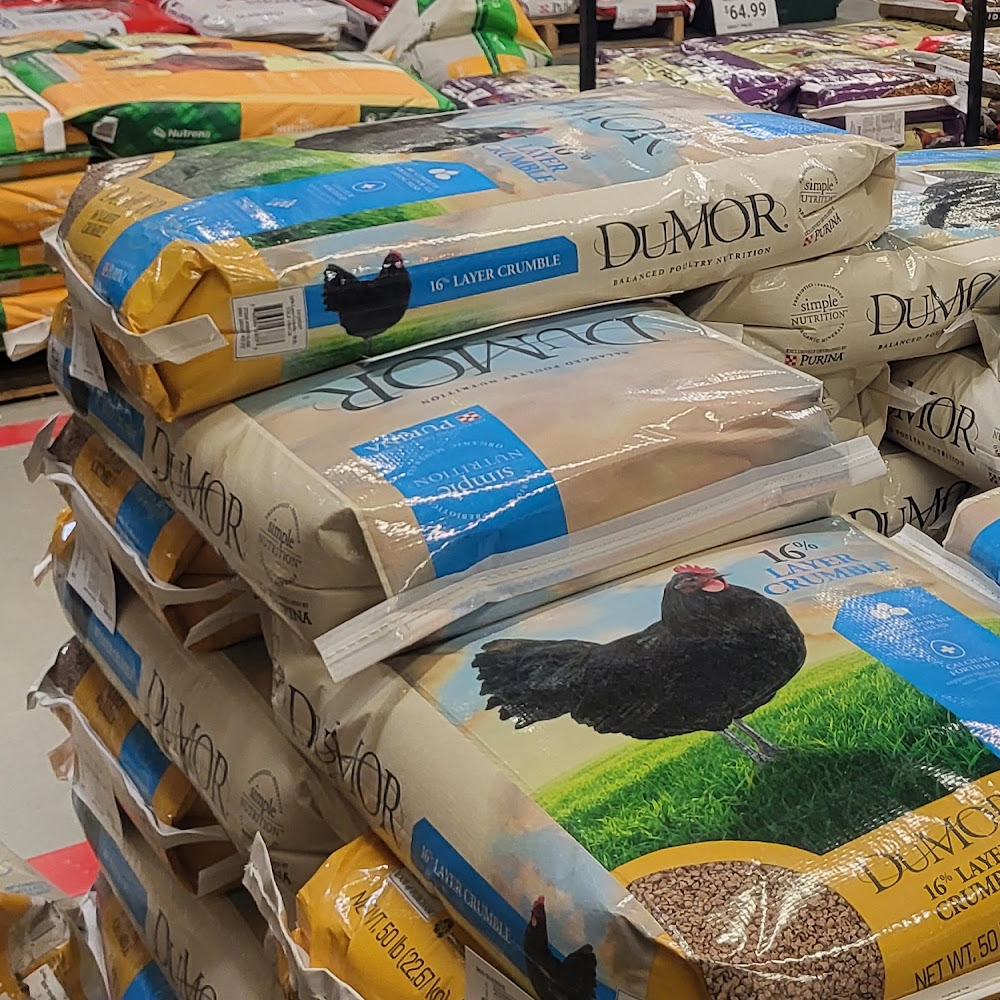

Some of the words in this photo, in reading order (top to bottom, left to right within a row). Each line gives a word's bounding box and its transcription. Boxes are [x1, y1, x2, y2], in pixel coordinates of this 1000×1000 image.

[167, 128, 211, 140] Nutrena
[804, 179, 835, 200] simple
[814, 213, 843, 243] PURINA
[453, 269, 495, 288] LAYER
[496, 254, 561, 280] CRUMBLE
[612, 268, 666, 287] BALANCED
[669, 258, 714, 274] POULTRY
[715, 246, 772, 264] NUTRITION
[791, 309, 848, 327] NUTRITION
[800, 294, 839, 315] simple
[878, 335, 922, 351] BALANCED
[503, 363, 560, 381] POULTRY
[564, 350, 630, 367] BALANCED
[799, 352, 844, 367] PURINA
[421, 376, 499, 406] NUTRITION
[412, 447, 525, 489] NUTRITION
[267, 518, 295, 551] simple
[758, 541, 819, 564] 16%
[763, 553, 862, 579] LAYER
[764, 560, 896, 596] CRUMBLE
[945, 655, 990, 671] CALCIUM
[950, 659, 1000, 677] FORTIFIED
[923, 871, 953, 901] 16%
[434, 858, 463, 898] LAYER
[463, 887, 513, 945] CRUMBLE
[375, 921, 400, 949] 50
[387, 934, 408, 961] lb
[396, 946, 437, 992] (22.67
[913, 959, 949, 993] NET
[946, 941, 979, 975] WT.
[978, 930, 999, 960] 50
